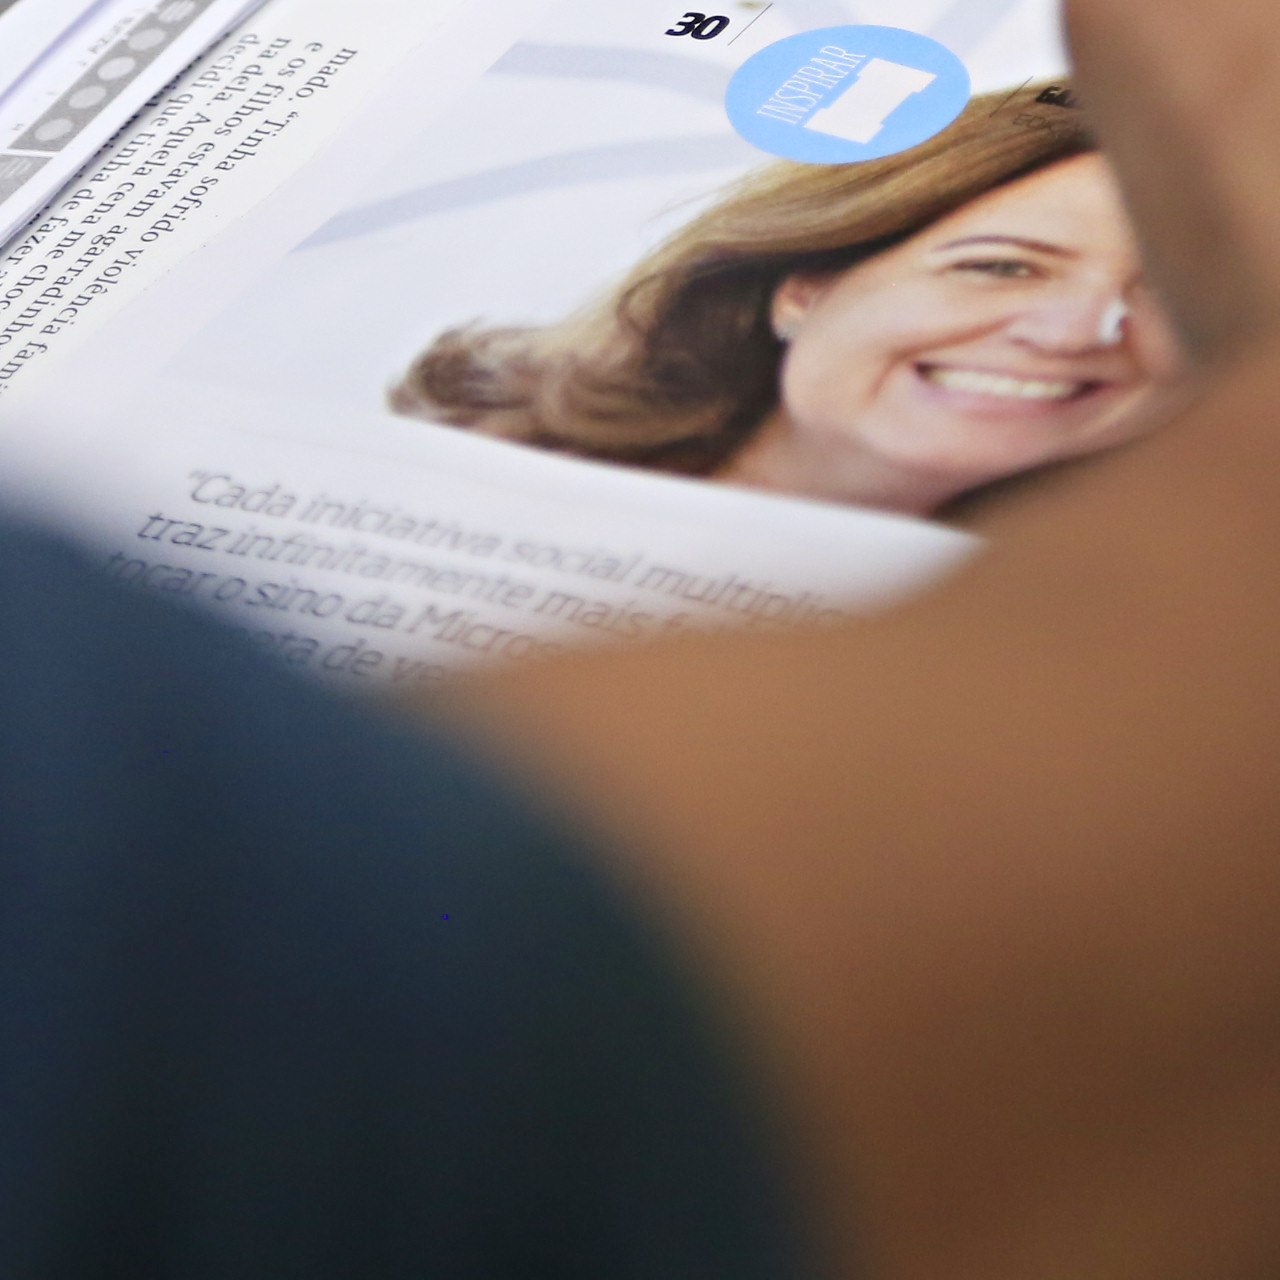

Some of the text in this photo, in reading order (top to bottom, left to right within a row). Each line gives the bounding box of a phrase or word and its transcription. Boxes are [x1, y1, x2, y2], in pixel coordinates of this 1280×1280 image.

[257, 38, 292, 59] na
[305, 42, 323, 53] e
[664, 11, 730, 40] 30
[191, 34, 260, 88] decidi
[206, 64, 264, 106] dela.
[277, 57, 306, 77] os
[288, 47, 358, 102] mado.
[756, 45, 866, 125] INSPIRAR
[153, 93, 194, 127] que
[213, 83, 285, 136] filhos
[89, 133, 156, 183] tinha
[131, 112, 212, 176] Aquela
[213, 111, 299, 171] “Tinha
[62, 188, 95, 211] de
[80, 181, 136, 225] cena
[123, 141, 216, 218] estavam
[140, 176, 219, 243] sofrido
[5, 216, 69, 266] fazer
[45, 229, 86, 260] me
[39, 249, 145, 335] violência
[136, 512, 230, 551] traz
[226, 525, 536, 608] infinitamente
[534, 588, 654, 640] mais
[213, 576, 247, 602] o
[244, 578, 344, 619] sino
[345, 593, 405, 630] da
[321, 637, 385, 678] de
